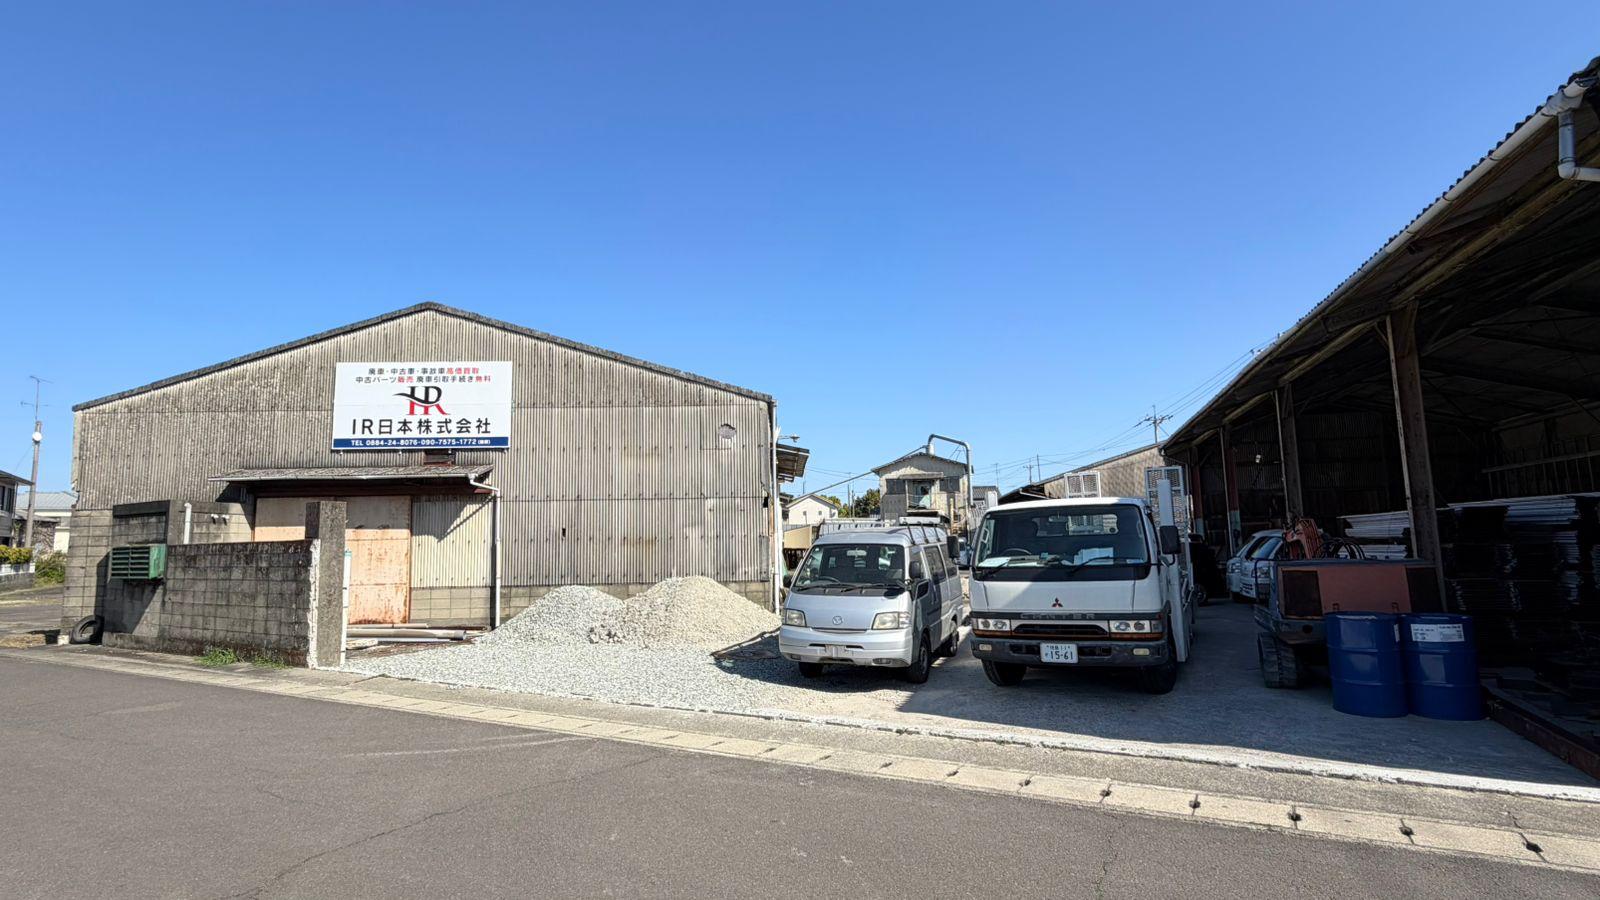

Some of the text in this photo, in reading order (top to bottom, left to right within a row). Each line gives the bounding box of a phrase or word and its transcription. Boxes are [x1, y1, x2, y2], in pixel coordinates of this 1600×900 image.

[352, 417, 491, 435] IR日本株式会社
[1050, 651, 1073, 660] 15-61
